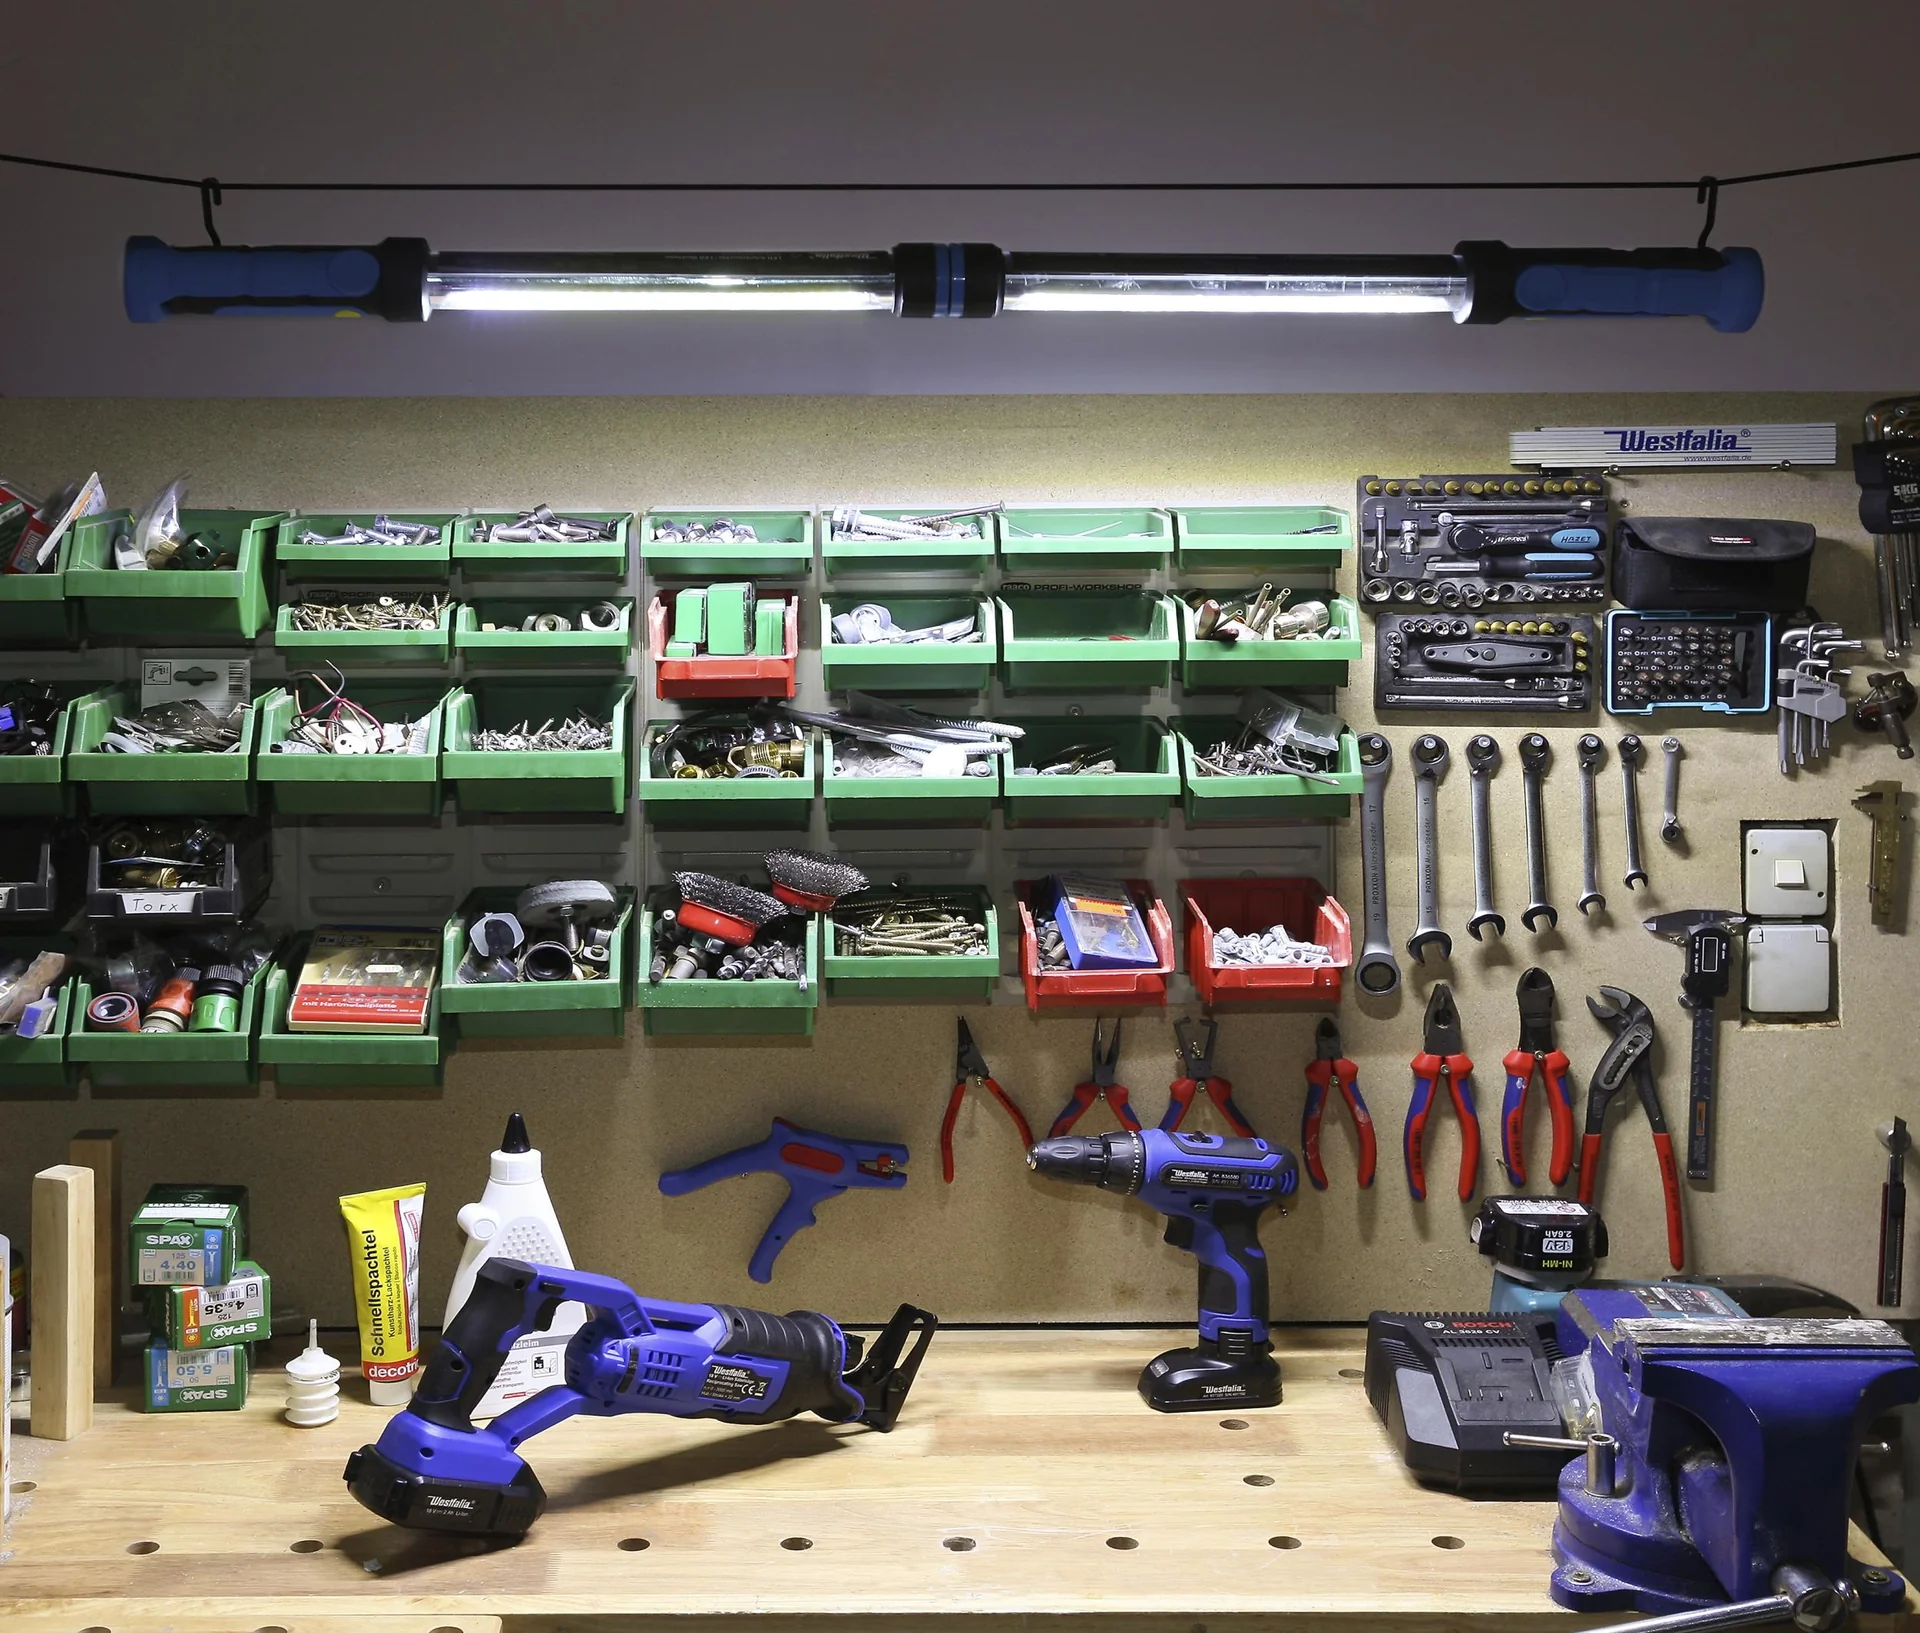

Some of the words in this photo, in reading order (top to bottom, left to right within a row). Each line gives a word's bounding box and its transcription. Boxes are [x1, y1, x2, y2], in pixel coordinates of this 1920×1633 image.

[1684, 453, 1751, 462] www.westfalia.de
[1560, 535, 1592, 544] HAZET
[1034, 583, 1142, 591] PROFI-WORKSHOP
[1423, 797, 1430, 806] 15
[1369, 804, 1376, 813] 17
[1424, 817, 1432, 864] MicroSpeeder
[1369, 822, 1378, 872] MicroSpeeder
[1424, 864, 1432, 894] PROXXON
[1370, 872, 1379, 905] PROXXON
[132, 897, 178, 912] Torx
[1426, 905, 1433, 914] 15
[1373, 912, 1380, 922] 19
[1171, 1169, 1208, 1178] Westfalia
[1544, 1230, 1572, 1238] 2.6Ah
[146, 1233, 194, 1248] SPAX
[1545, 1240, 1571, 1251] 12V
[1542, 1259, 1573, 1268] Ni-MH
[362, 1229, 385, 1357] Schnellspachtel
[382, 1246, 396, 1338] Kunstharz-Lackspachtel
[217, 1313, 232, 1321] 125
[210, 1323, 257, 1340] SPAX
[368, 1358, 420, 1378] decotri
[711, 1364, 749, 1379] Westfalia
[706, 1378, 734, 1388] Reciprocating
[1201, 1384, 1246, 1394] Westfalia
[179, 1388, 228, 1403] SPAX
[427, 1495, 474, 1510] Westfalia
